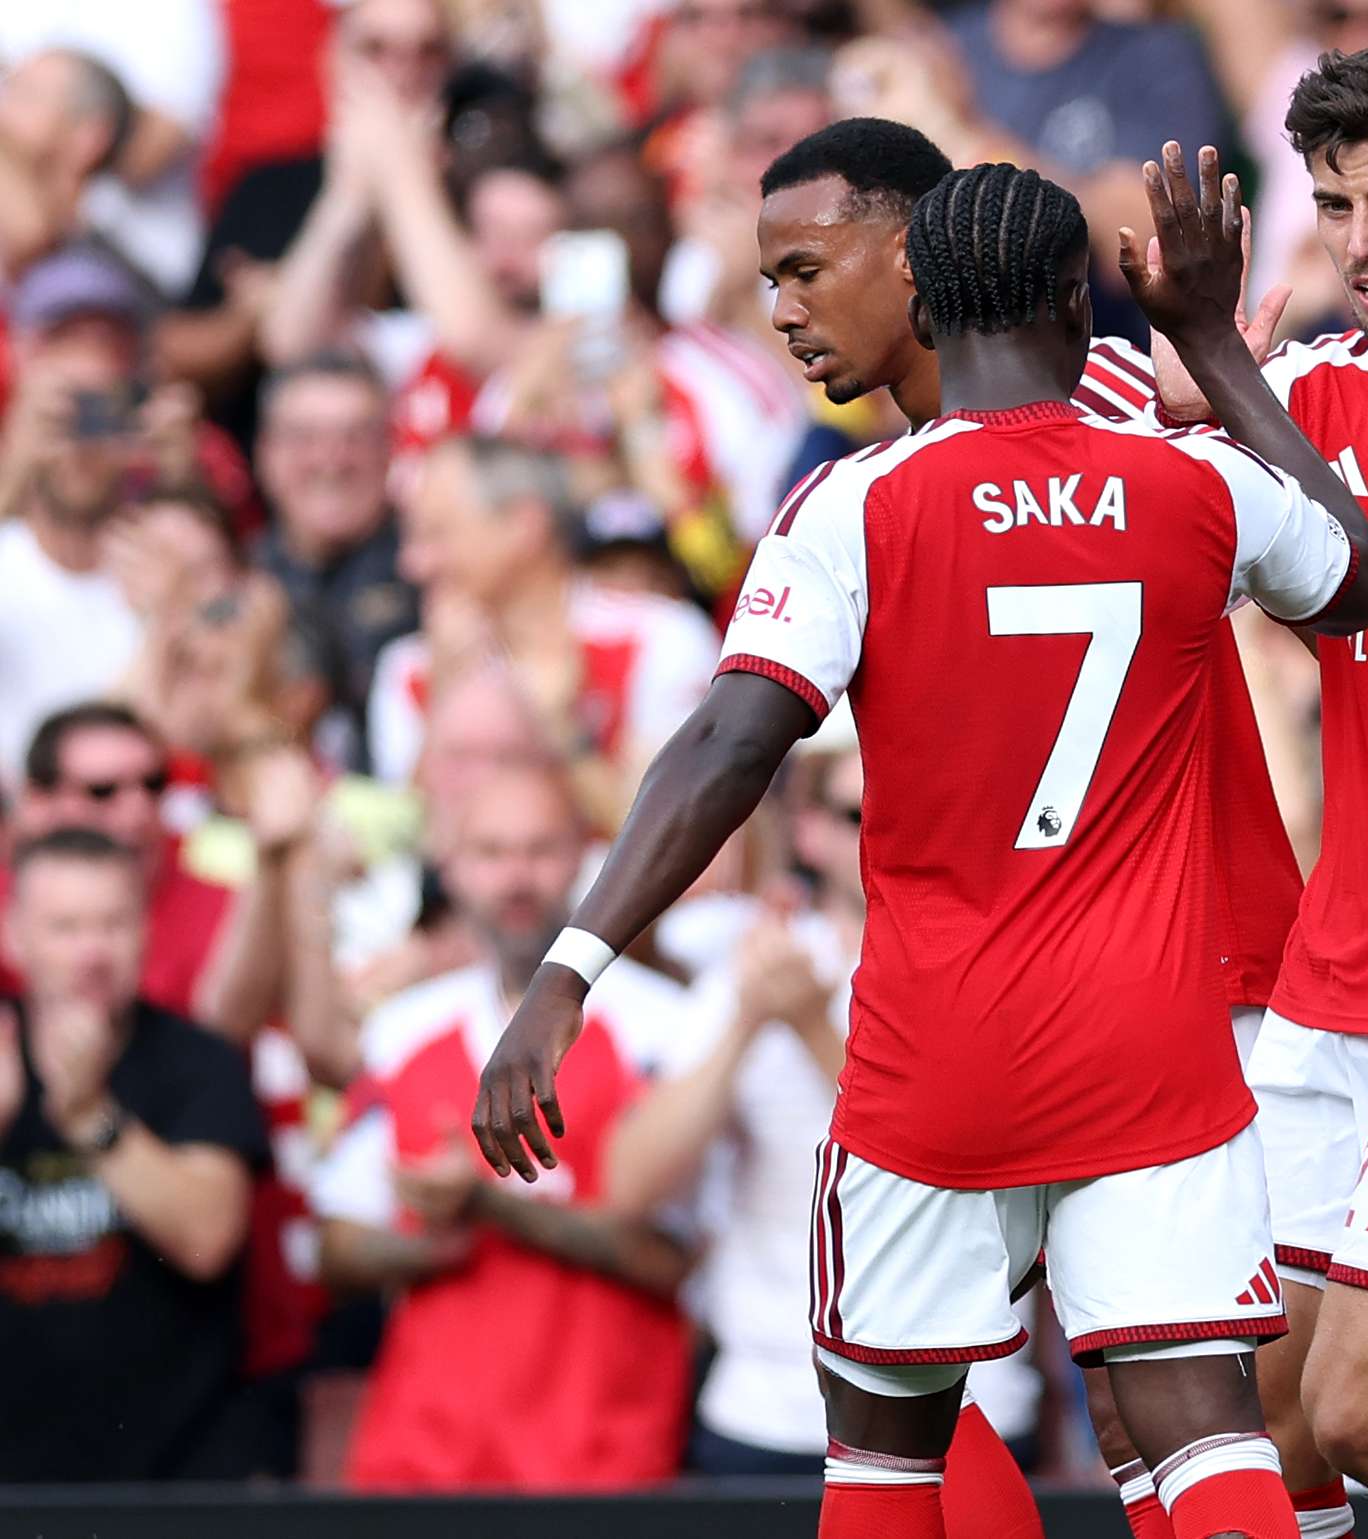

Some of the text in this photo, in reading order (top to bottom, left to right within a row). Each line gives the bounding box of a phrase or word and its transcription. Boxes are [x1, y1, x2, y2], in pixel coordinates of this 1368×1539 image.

[972, 473, 1127, 535] SAKA
[732, 586, 792, 624] eel.
[986, 580, 1144, 851] 7
